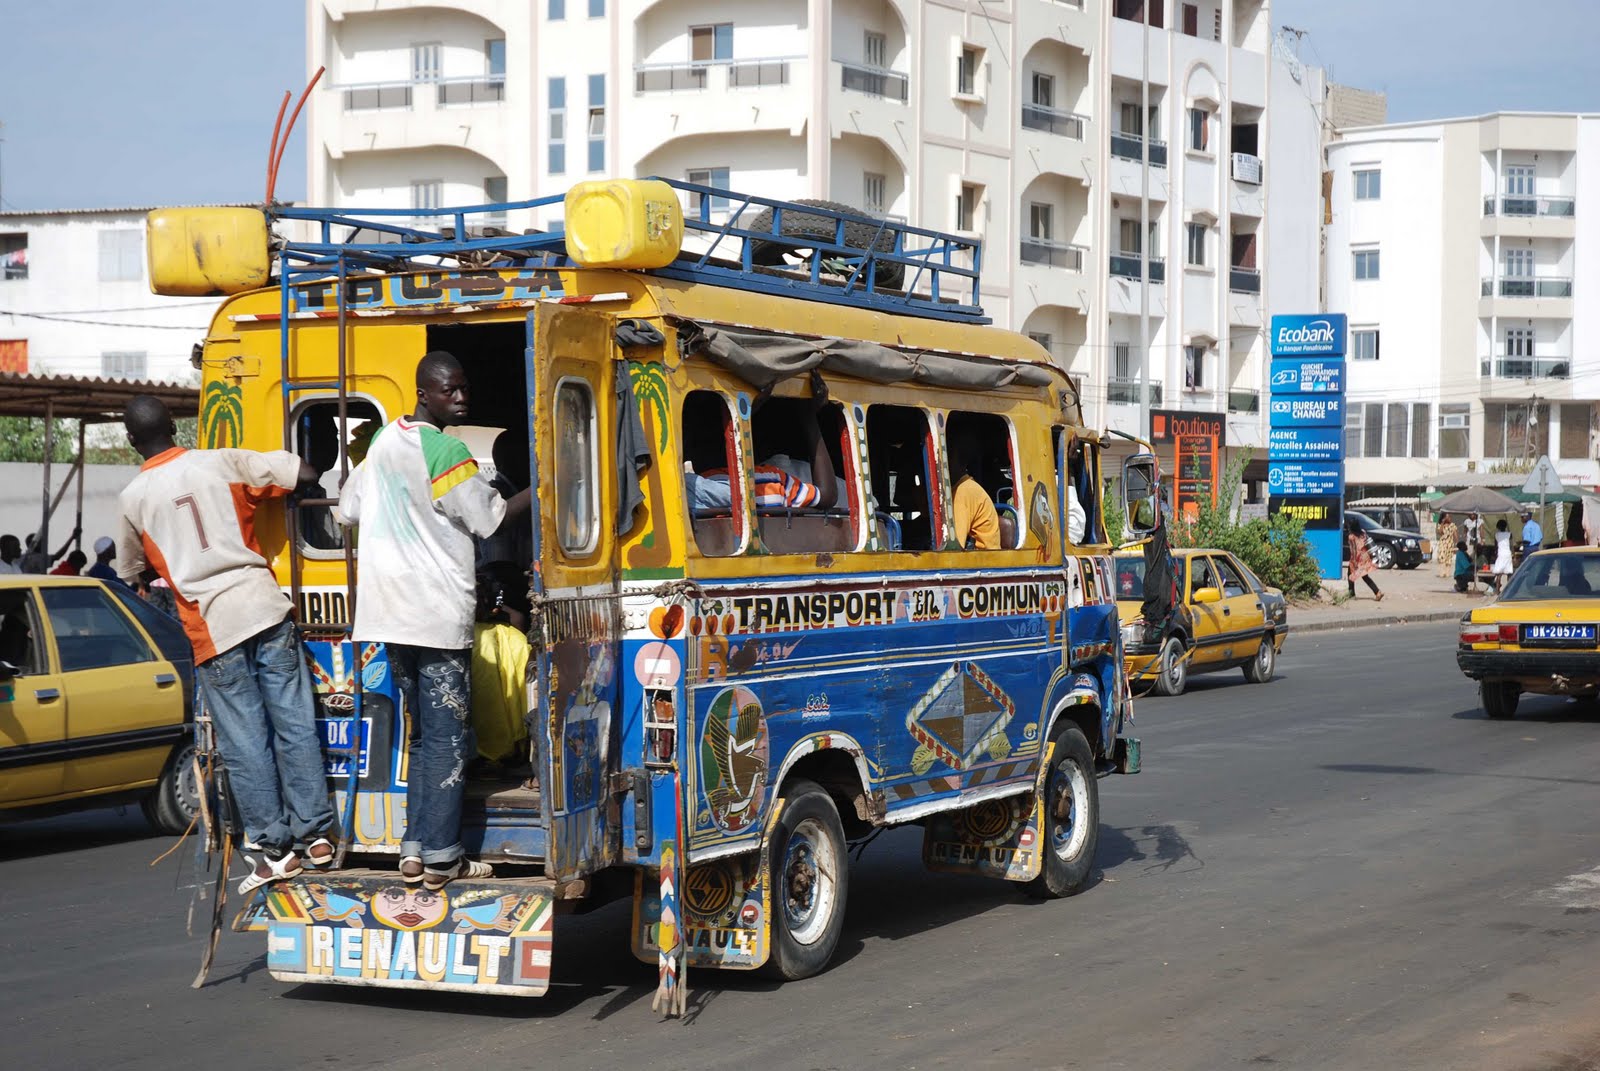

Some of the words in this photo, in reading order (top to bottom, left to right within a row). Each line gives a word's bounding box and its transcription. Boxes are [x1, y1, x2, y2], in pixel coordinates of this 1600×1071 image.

[296, 270, 566, 309] TOUBA
[1278, 320, 1335, 342] Ecobank
[1292, 401, 1326, 410] BUREAU
[1327, 401, 1339, 410] DE
[1292, 410, 1326, 419] CHANGE
[1171, 415, 1221, 436] boutique
[1270, 431, 1297, 440] AGENCE
[1270, 441, 1303, 450] Parcelles
[1304, 441, 1340, 450] Assainies
[733, 591, 896, 633] TRANSPORT
[957, 584, 1041, 618] COMMUN
[328, 721, 349, 745] DK
[643, 924, 758, 956] NAULT
[306, 925, 511, 984] RENAULT
